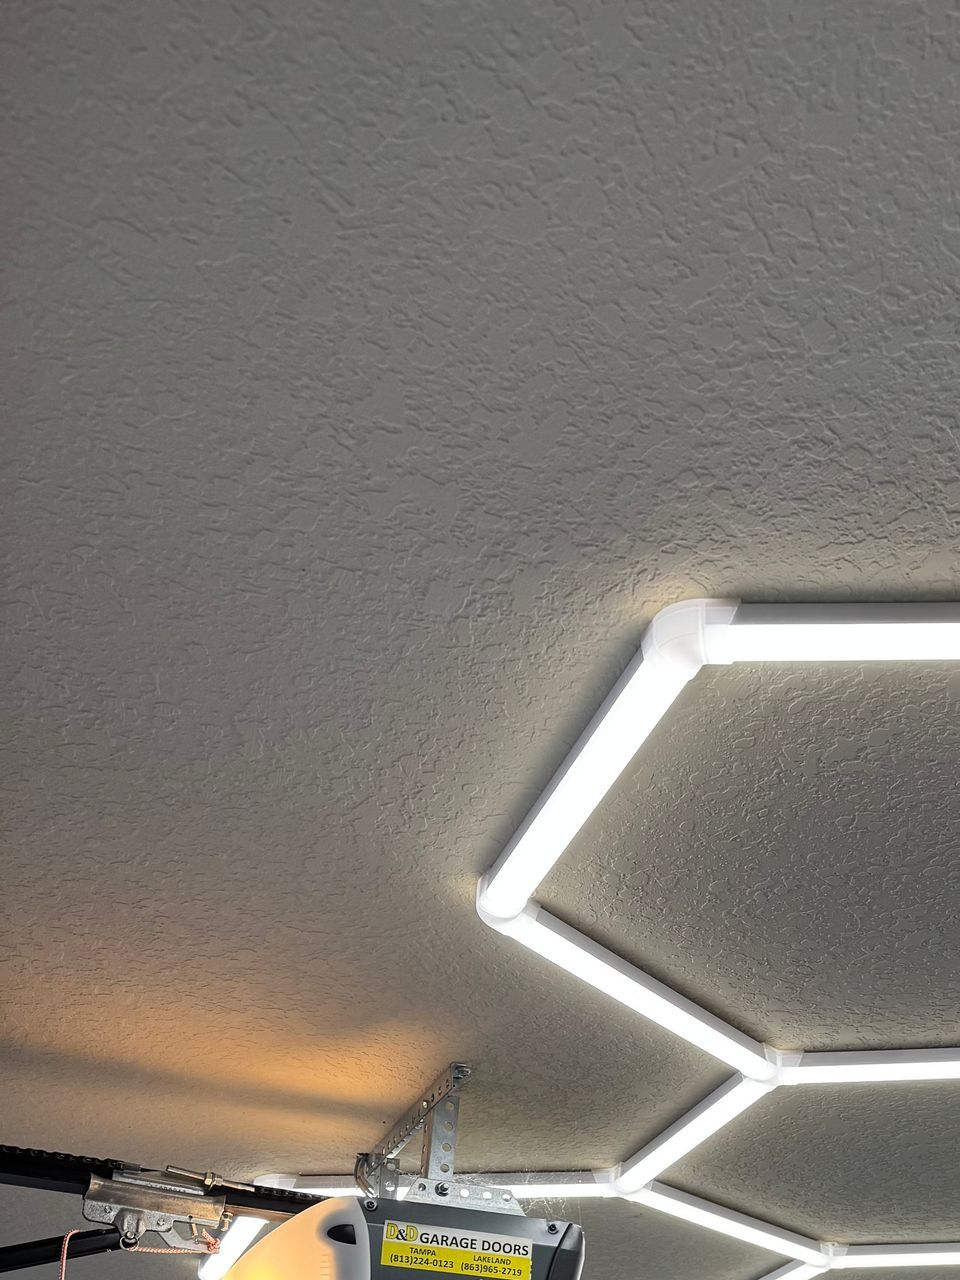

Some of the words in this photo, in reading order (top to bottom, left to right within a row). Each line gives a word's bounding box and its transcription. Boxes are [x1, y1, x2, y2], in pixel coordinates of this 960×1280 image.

[386, 1222, 419, 1242] D&D
[419, 1232, 477, 1250] GARAGE
[481, 1240, 529, 1256] DOORS
[409, 1247, 436, 1257] TAMPA
[390, 1253, 454, 1269] (813)224-0123
[473, 1255, 511, 1266] LAKELAND
[460, 1262, 522, 1277] (863)965-2719
